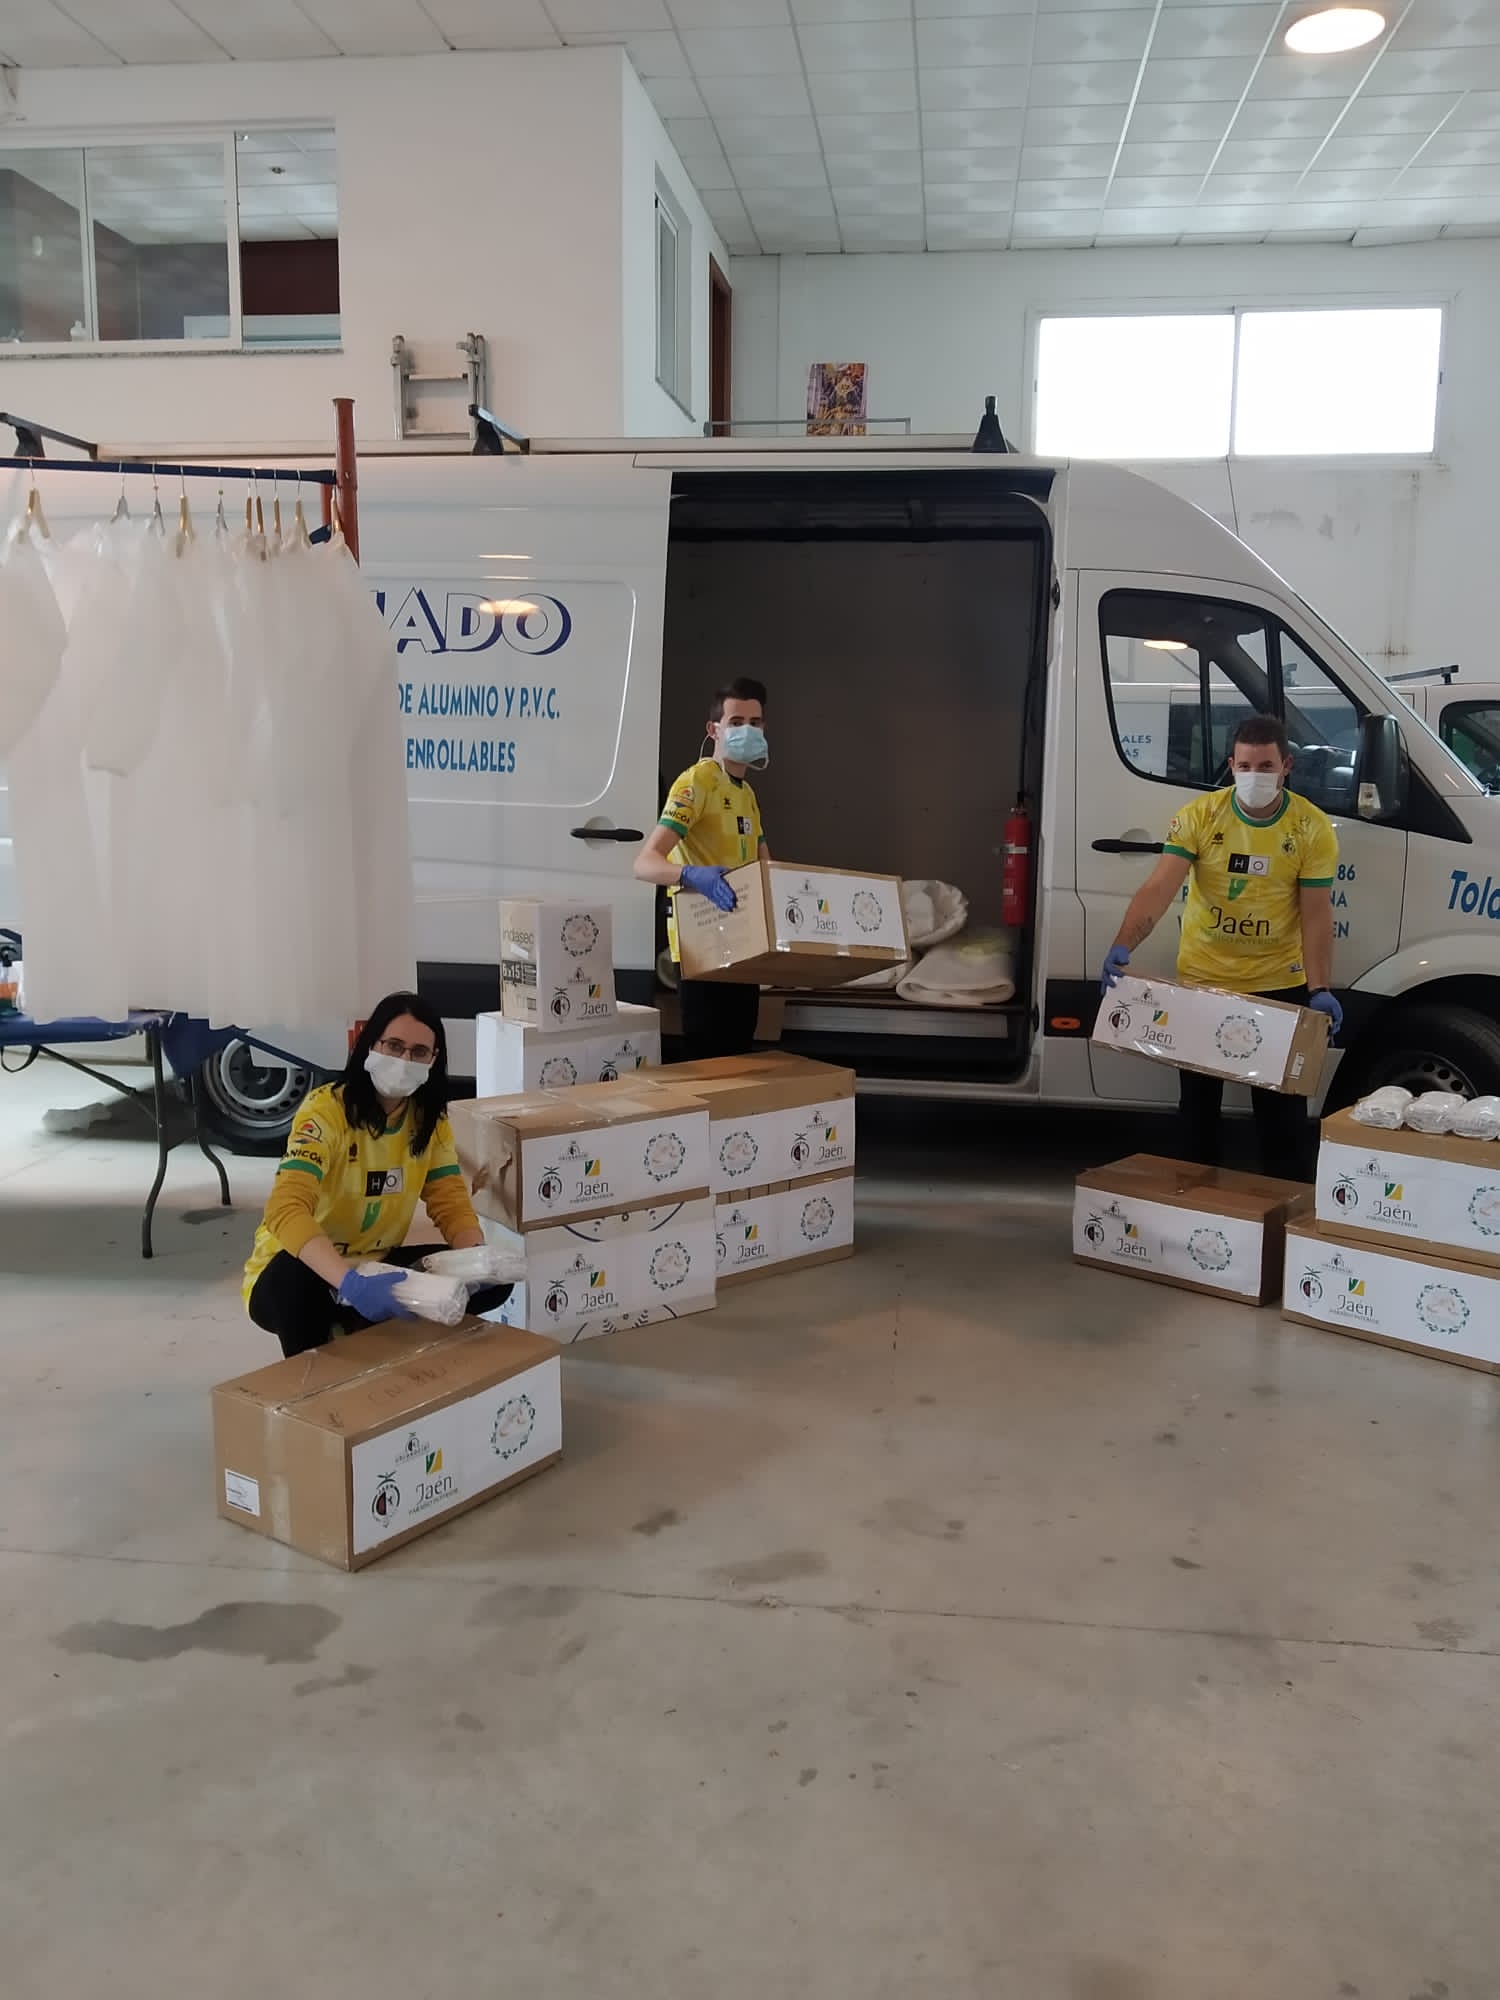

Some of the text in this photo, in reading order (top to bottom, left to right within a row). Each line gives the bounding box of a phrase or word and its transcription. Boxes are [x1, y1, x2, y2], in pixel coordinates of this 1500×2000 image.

[371, 586, 571, 655] ADO
[418, 683, 499, 717] ALUMINIO
[504, 687, 515, 718] Y
[520, 687, 560, 720] P.V.C.
[406, 738, 516, 773] ENROLLABLES
[1337, 863, 1356, 881] 86
[1208, 905, 1270, 937] Jaén
[1142, 1024, 1173, 1045] Jaén
[818, 1144, 843, 1160] Jaén
[576, 1180, 609, 1198] Jaén
[1373, 1200, 1412, 1222] Jaén
[737, 1243, 765, 1258] Jaén
[1116, 1238, 1147, 1257] Jaén
[581, 1290, 614, 1308] Jaén
[1337, 1295, 1374, 1318] Jaén
[415, 1474, 453, 1503] Jaén
